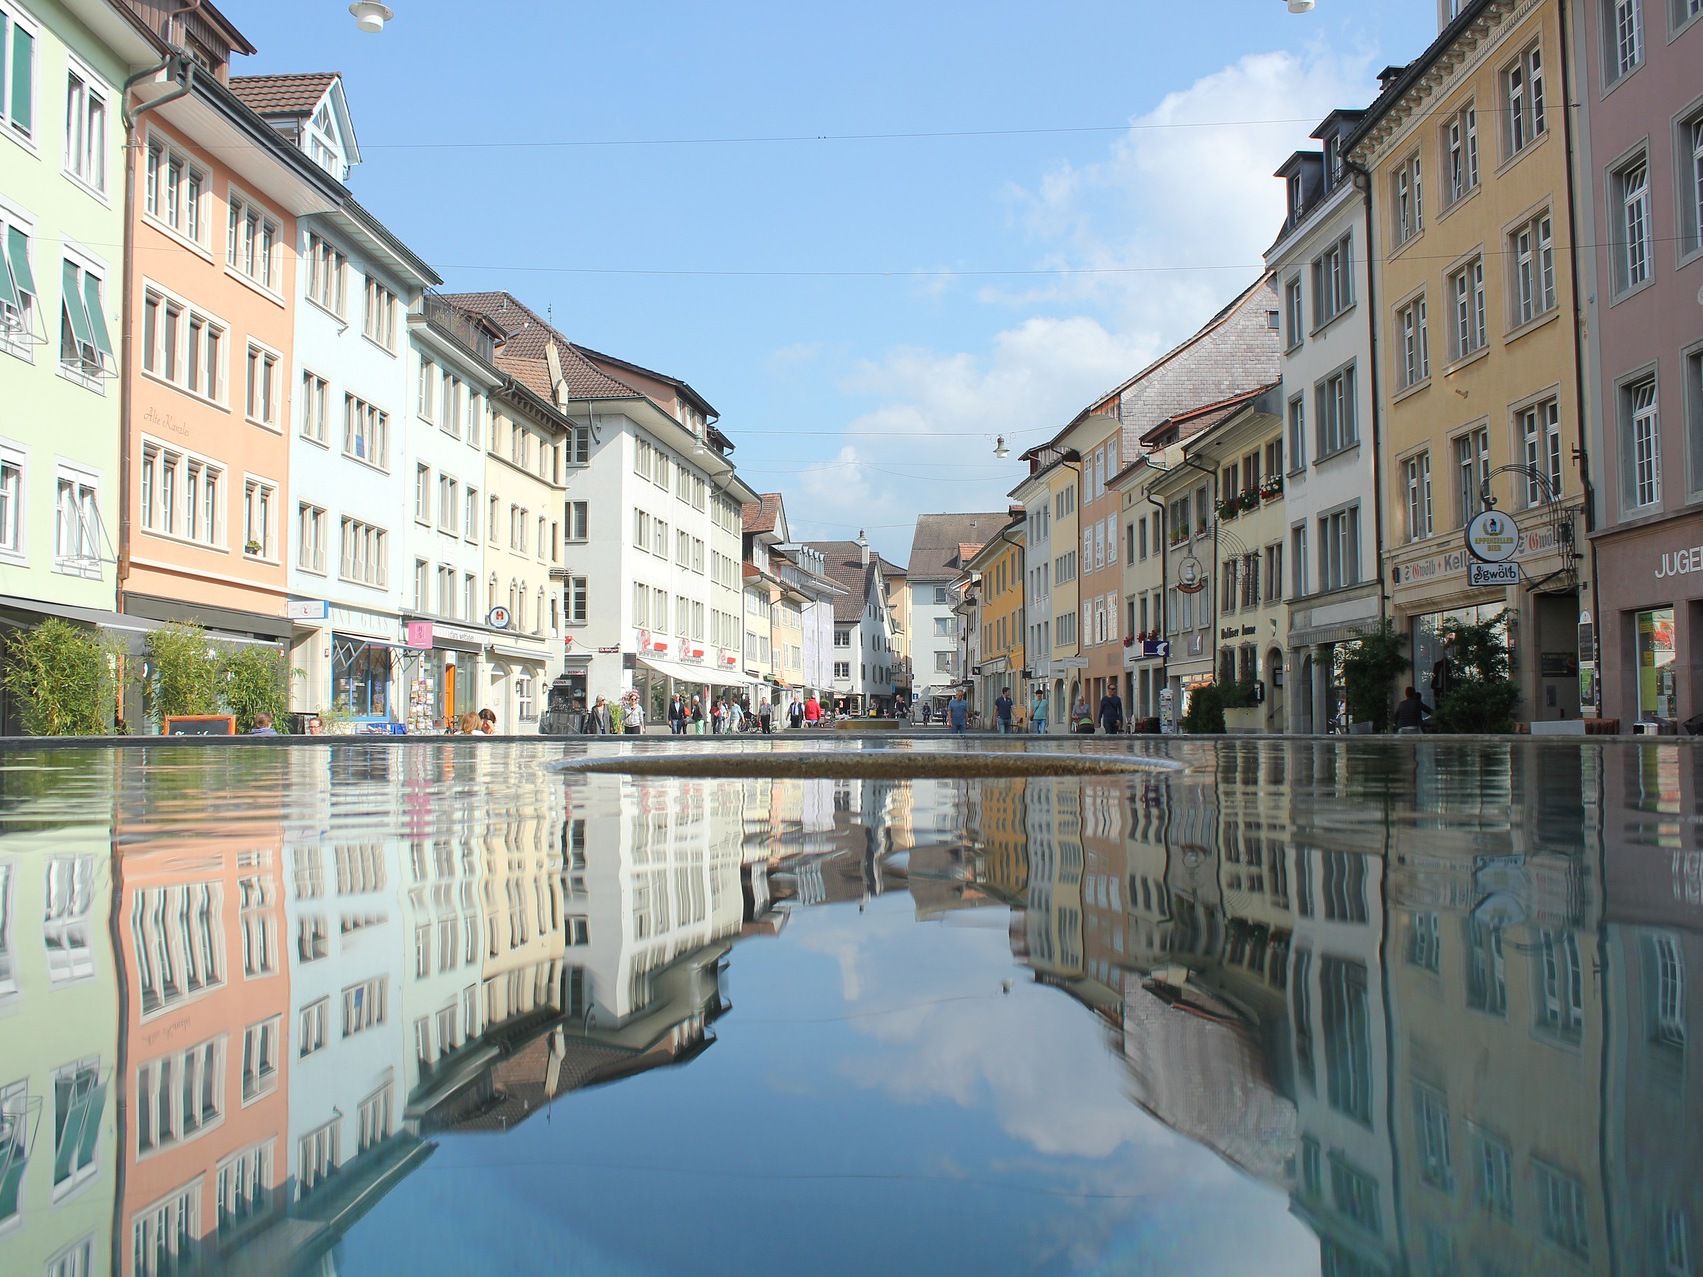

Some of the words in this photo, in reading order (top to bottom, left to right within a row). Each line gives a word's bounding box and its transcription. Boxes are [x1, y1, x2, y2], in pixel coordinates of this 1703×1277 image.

[144, 406, 161, 425] Alte
[1474, 537, 1514, 545] APPENZELLER
[1487, 544, 1502, 552] BIER
[1443, 551, 1475, 573] Kelle
